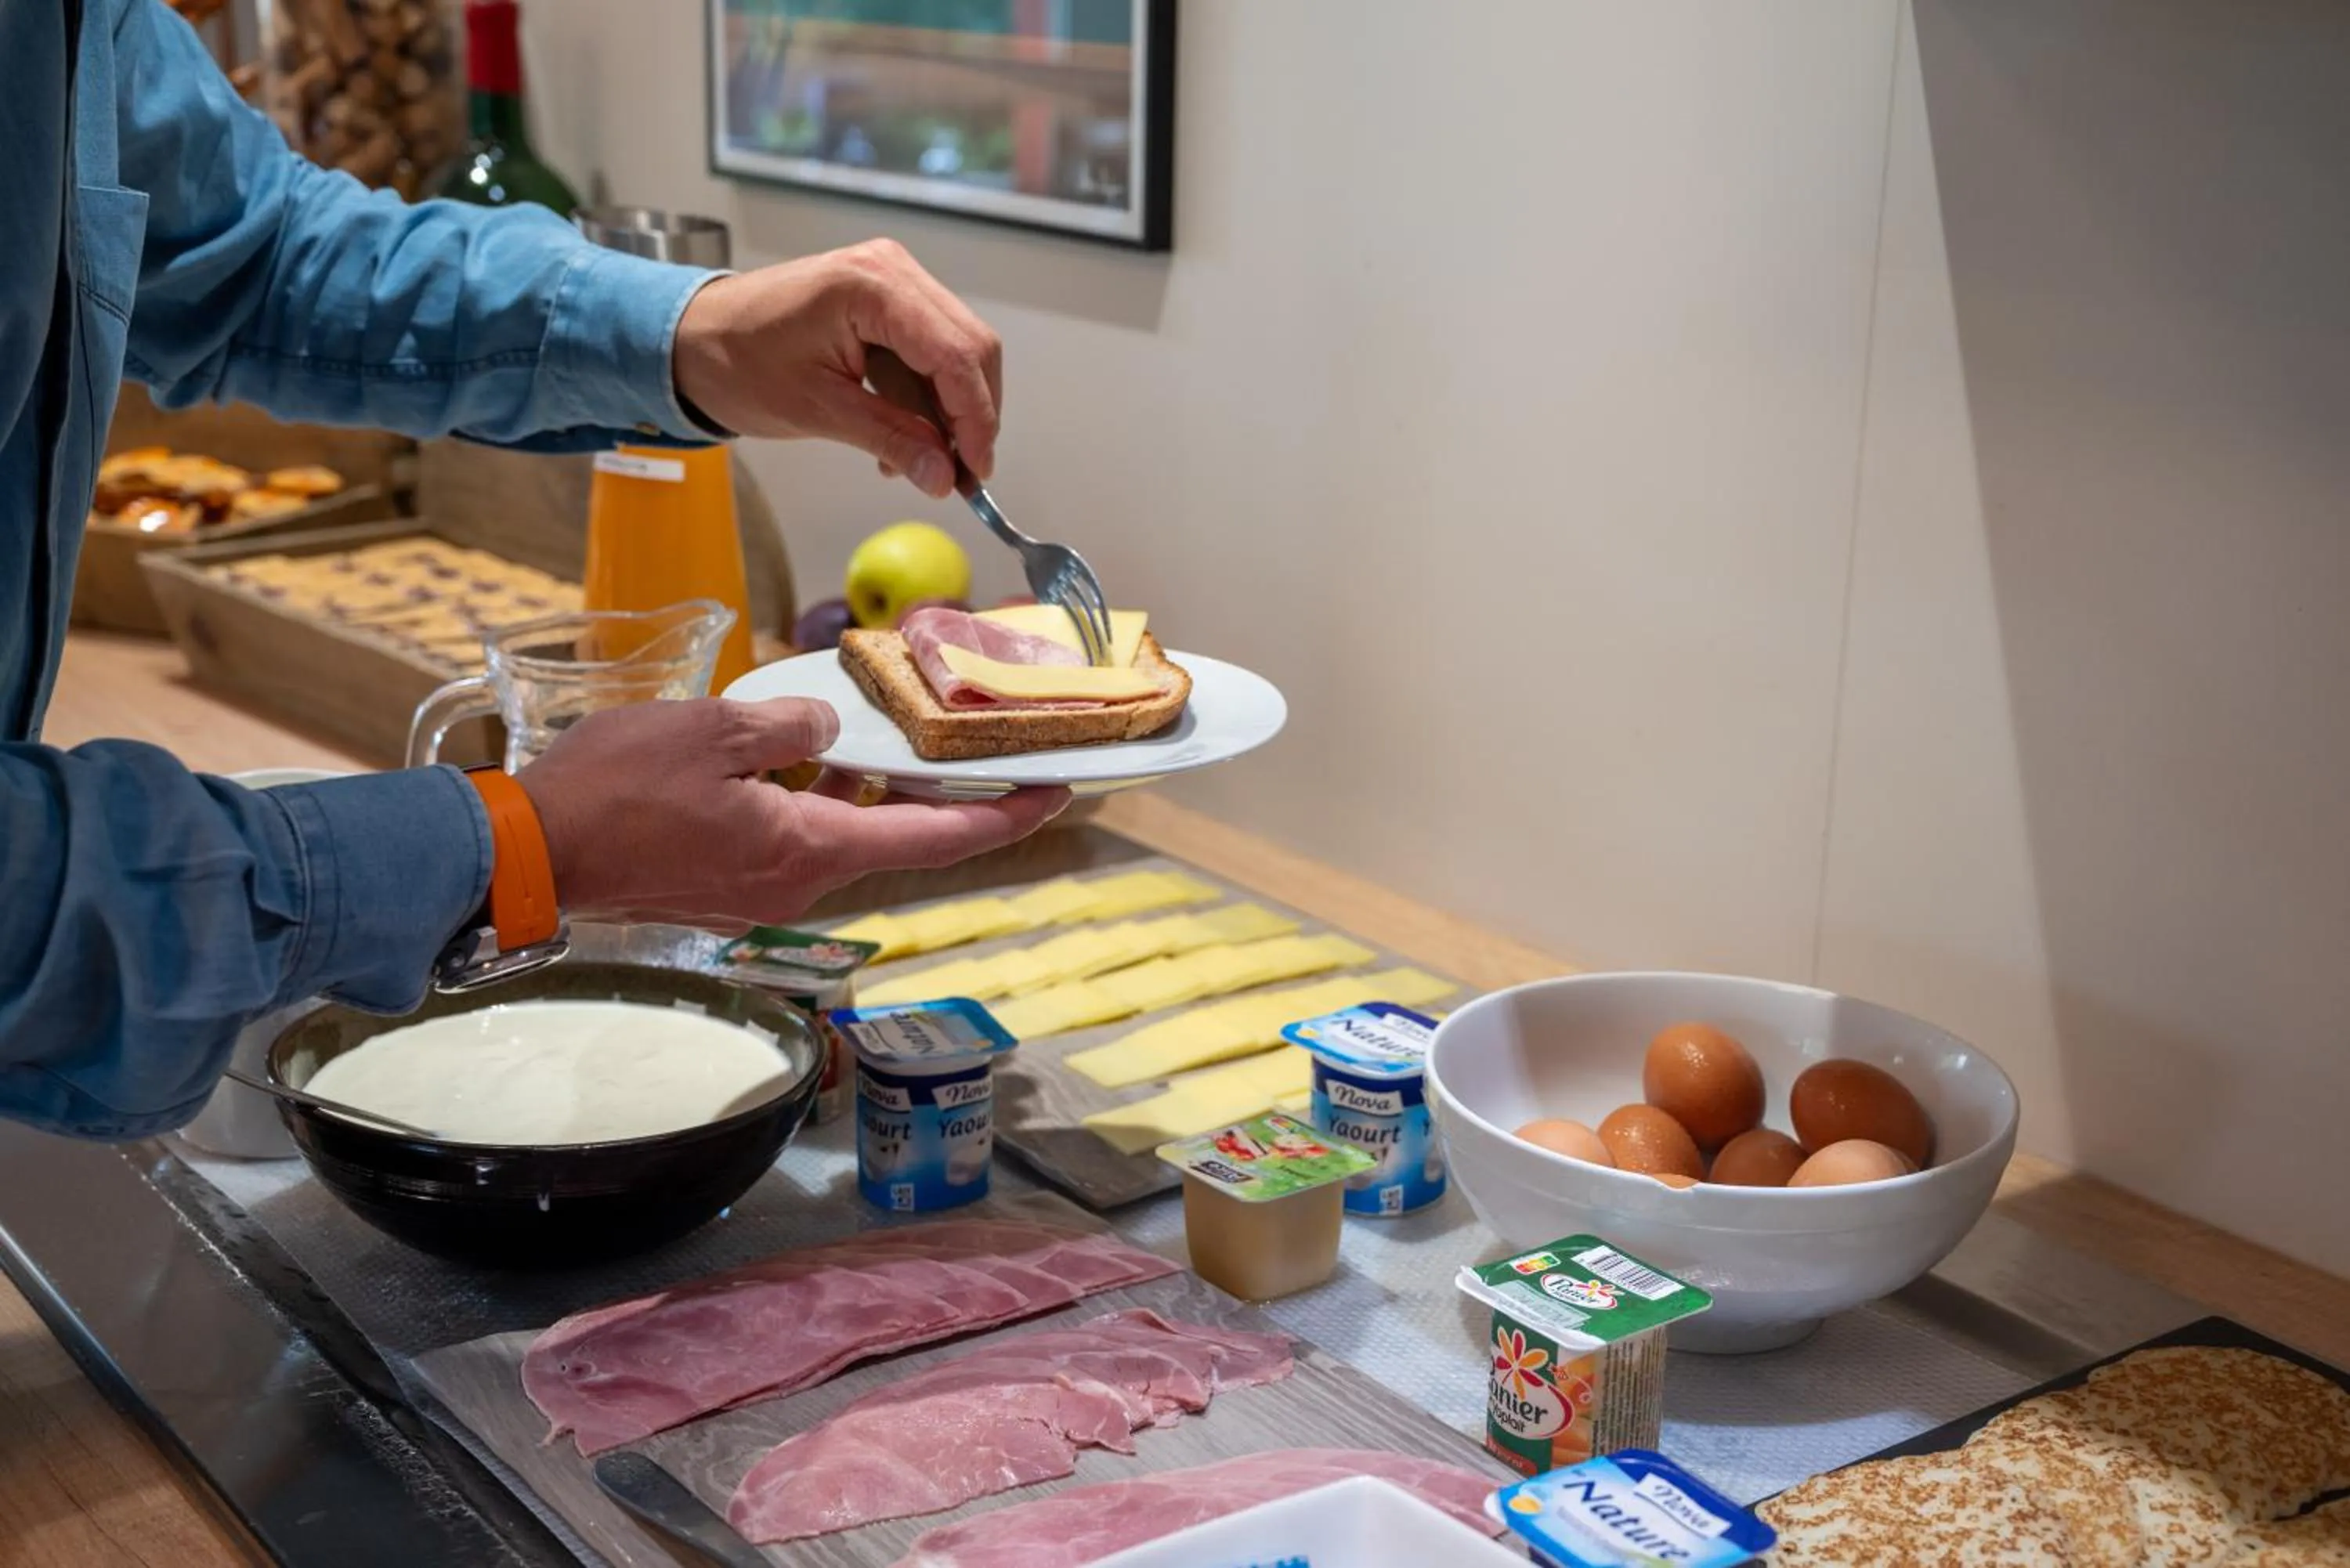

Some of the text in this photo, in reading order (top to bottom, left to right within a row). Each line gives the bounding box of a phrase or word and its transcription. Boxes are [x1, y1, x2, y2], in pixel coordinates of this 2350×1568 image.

[1329, 1020, 1425, 1057] Nature
[1335, 1086, 1391, 1110] Nova
[864, 1115, 912, 1140] ourt
[938, 1113, 990, 1138] Yaou
[1329, 1114, 1401, 1143] Yaourt
[1563, 1480, 1690, 1559] Nature
